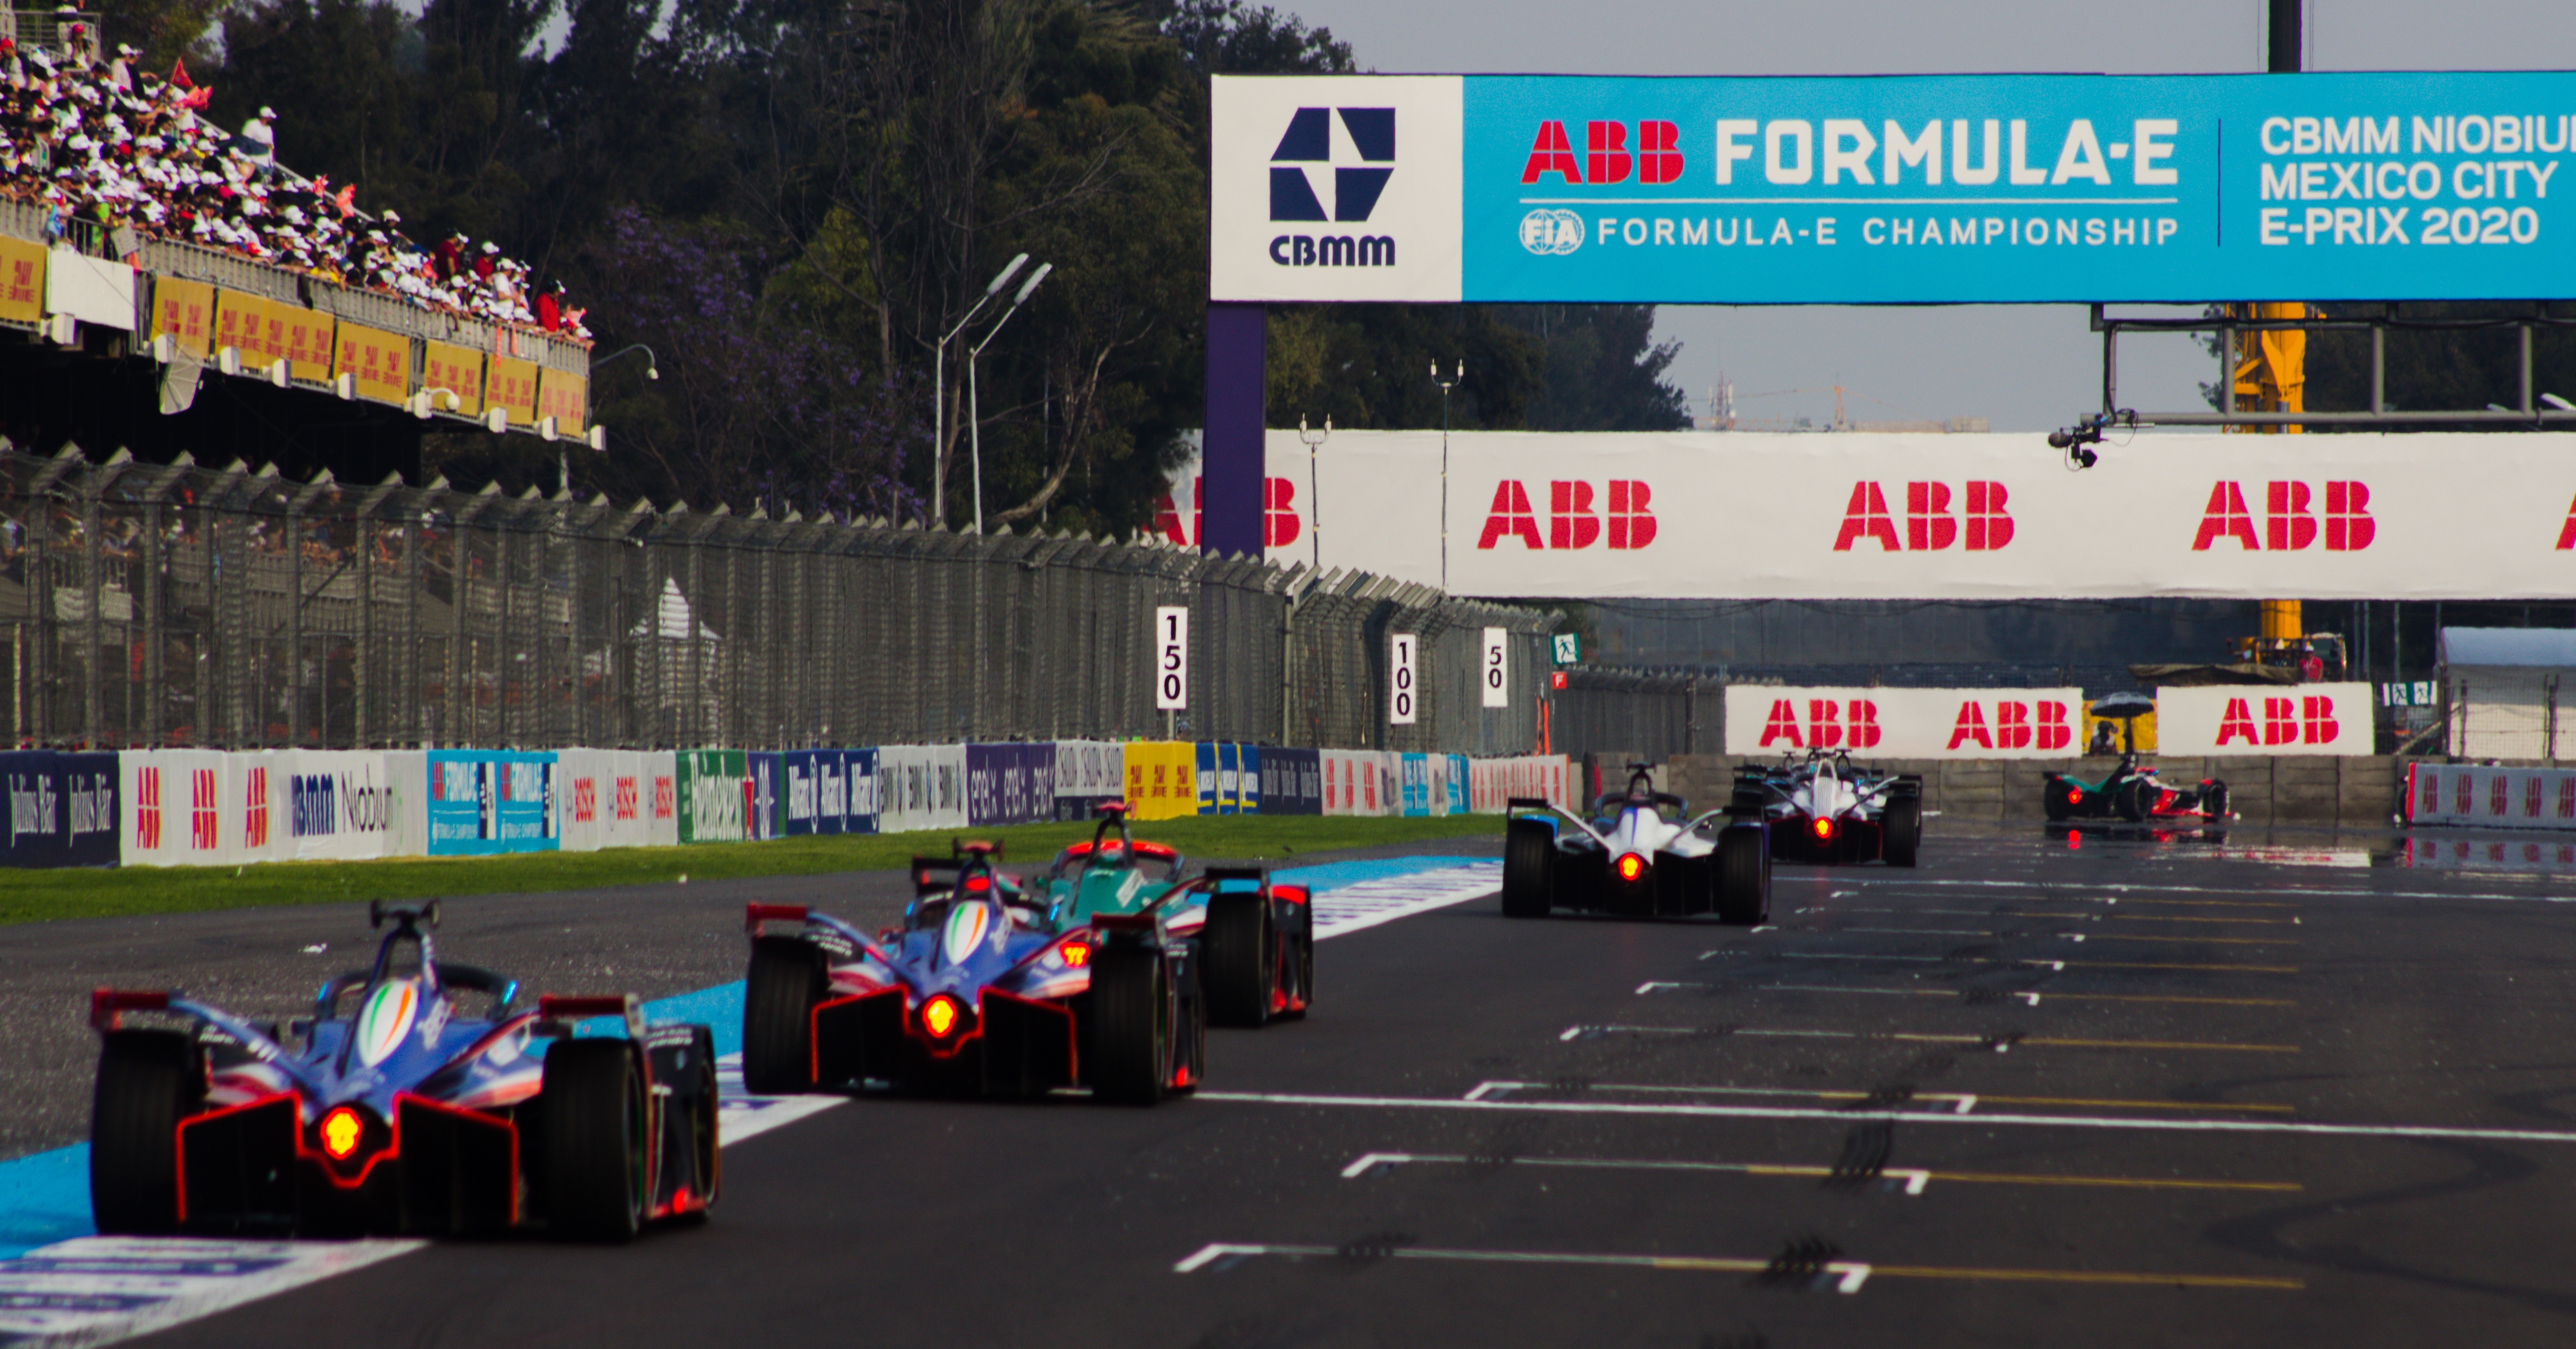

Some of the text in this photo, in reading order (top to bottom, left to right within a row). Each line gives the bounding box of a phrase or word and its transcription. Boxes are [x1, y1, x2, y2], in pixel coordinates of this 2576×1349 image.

[1521, 119, 2178, 185] ABB FORMULA-E
[2261, 116, 2576, 155] CBMM NIOBIU
[2261, 161, 2559, 200] MEXICO CITY
[1598, 218, 1836, 245] FORMULA-E
[1863, 218, 2177, 245] CHAMPIONSHIP
[2260, 206, 2539, 245] E-PRIX 2020
[1478, 480, 1657, 550] ABB
[1833, 480, 2015, 552] ABB
[2192, 480, 2376, 552] ABB
[1164, 615, 1181, 700] 150
[1397, 641, 1411, 716] 100
[1488, 645, 1502, 689] 50
[1556, 674, 1564, 687] F
[1759, 699, 1882, 748] ABB
[1946, 700, 2071, 750] ABB
[2215, 695, 2339, 746] ABB
[689, 753, 743, 840] Heineken
